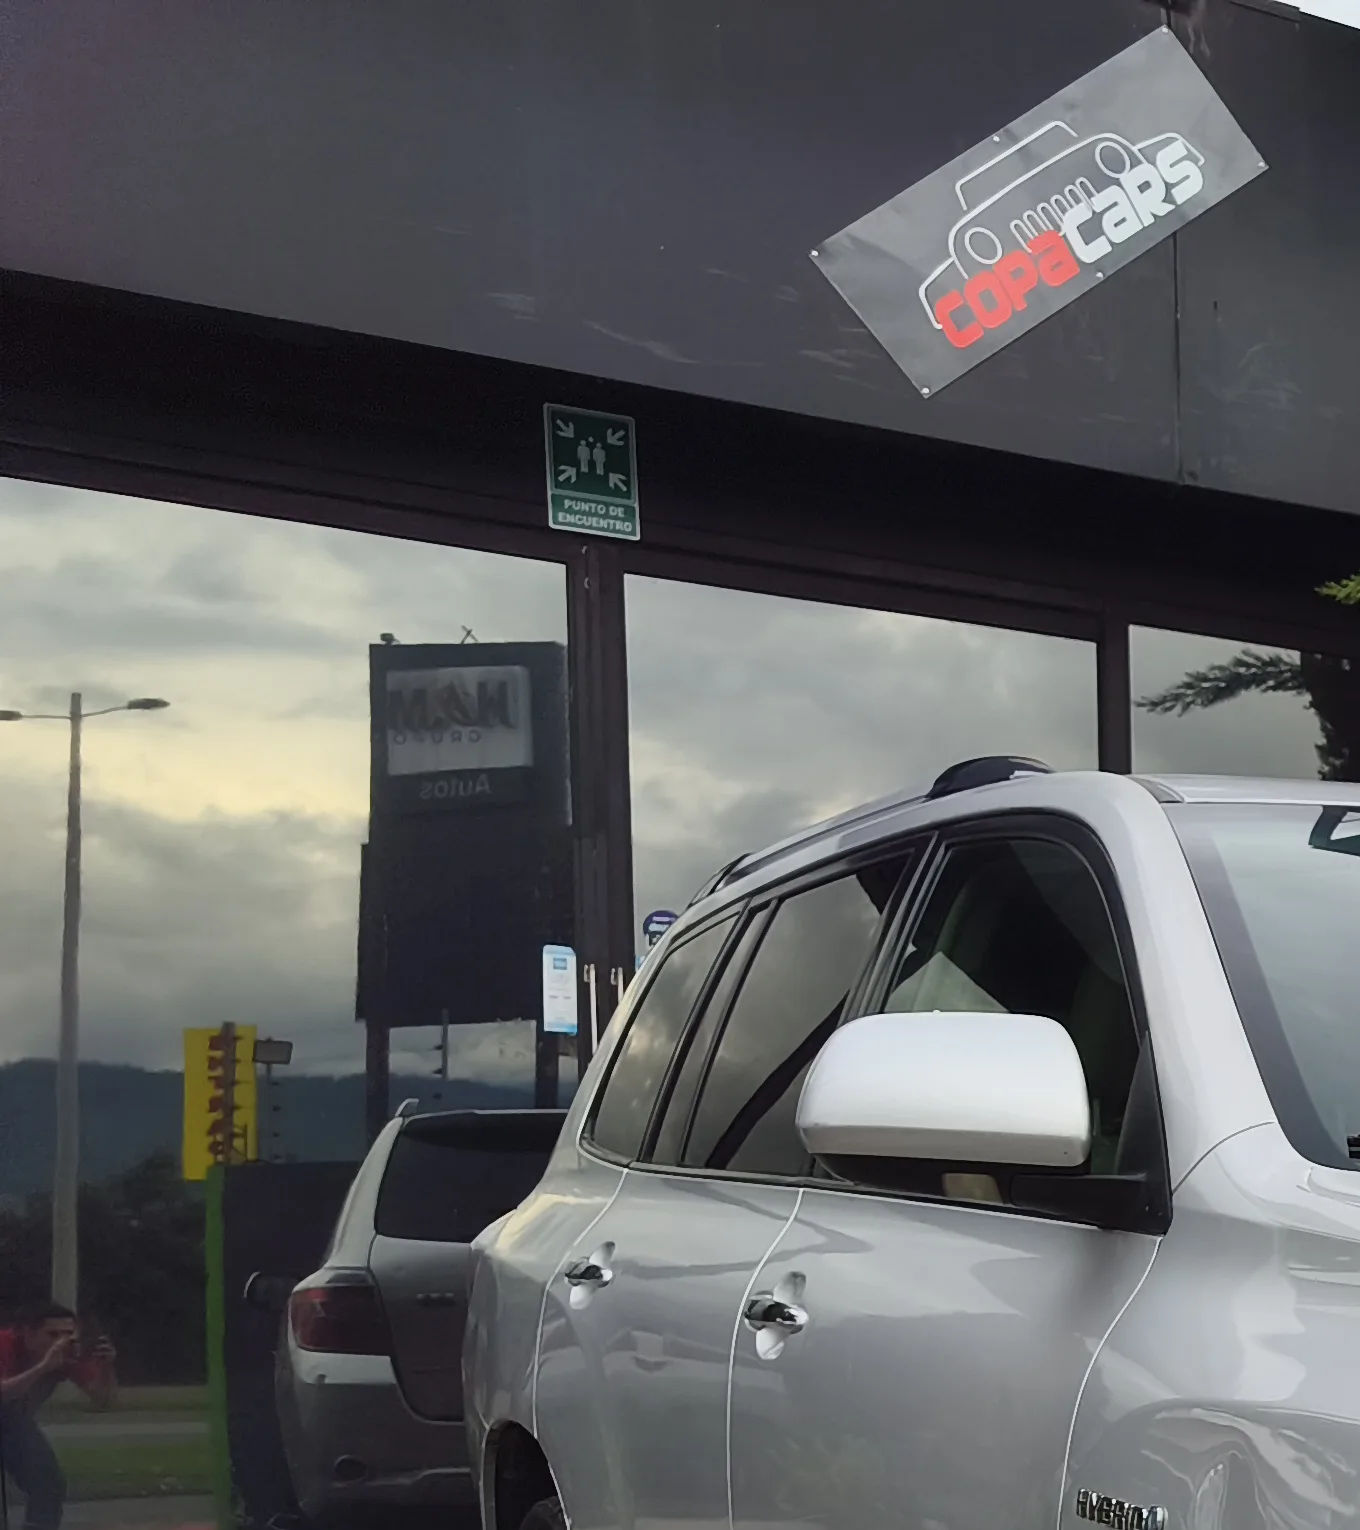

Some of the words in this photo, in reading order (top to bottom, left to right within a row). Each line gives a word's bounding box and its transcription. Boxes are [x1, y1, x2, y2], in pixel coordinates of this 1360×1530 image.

[564, 499, 606, 514] PUNTO
[609, 505, 625, 517] DE
[558, 511, 633, 532] ENCUENTRO
